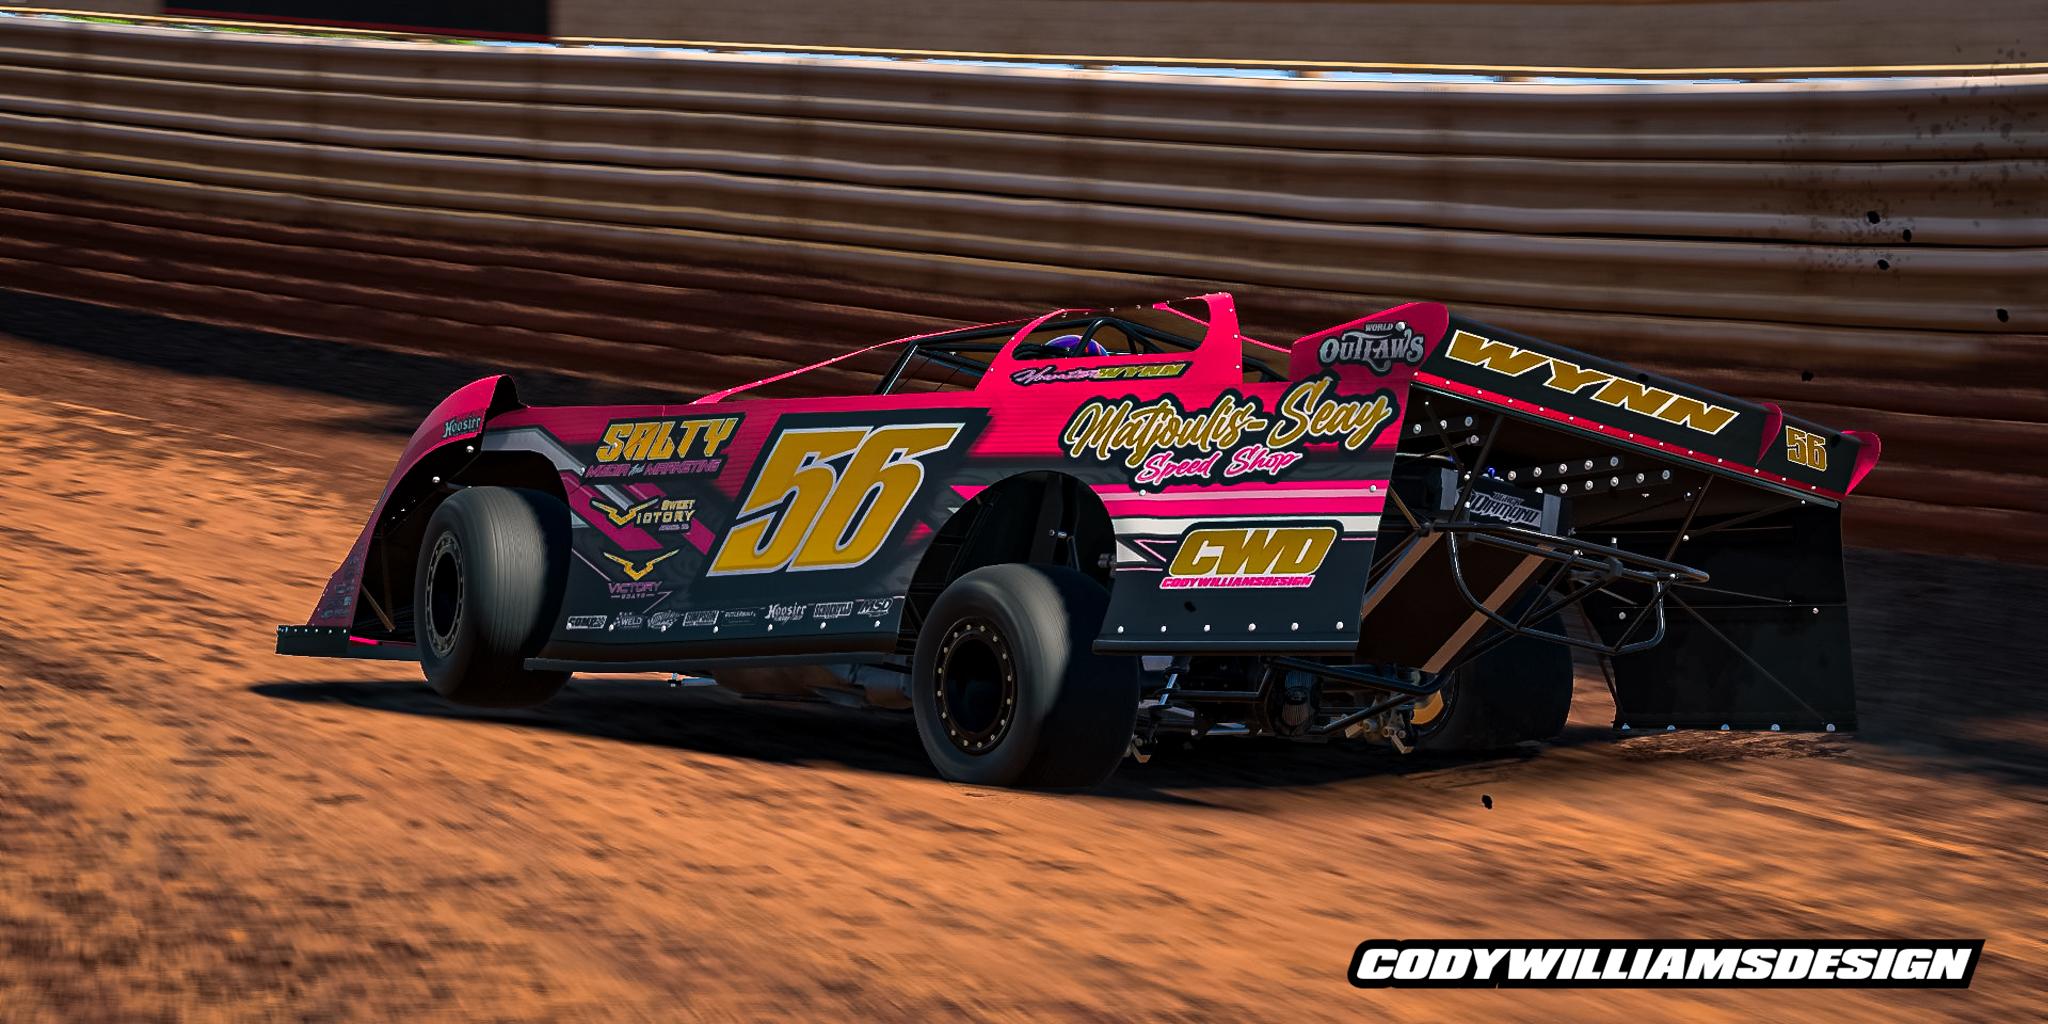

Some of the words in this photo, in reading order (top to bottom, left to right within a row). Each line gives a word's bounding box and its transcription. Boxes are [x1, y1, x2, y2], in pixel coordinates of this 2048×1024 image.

[1365, 323, 1394, 332] WORLD
[1098, 363, 1186, 379] WYNN
[1445, 329, 1740, 436] WYNN
[1266, 376, 1391, 451] Seay
[596, 417, 739, 462] SALTY
[1785, 426, 1828, 473] 56
[1134, 450, 1217, 485] Speed
[1223, 444, 1303, 478] Shop
[706, 422, 966, 577] 56
[1169, 527, 1338, 577] CWD
[1160, 575, 1316, 589] CODYWILLIAMSDESIGN
